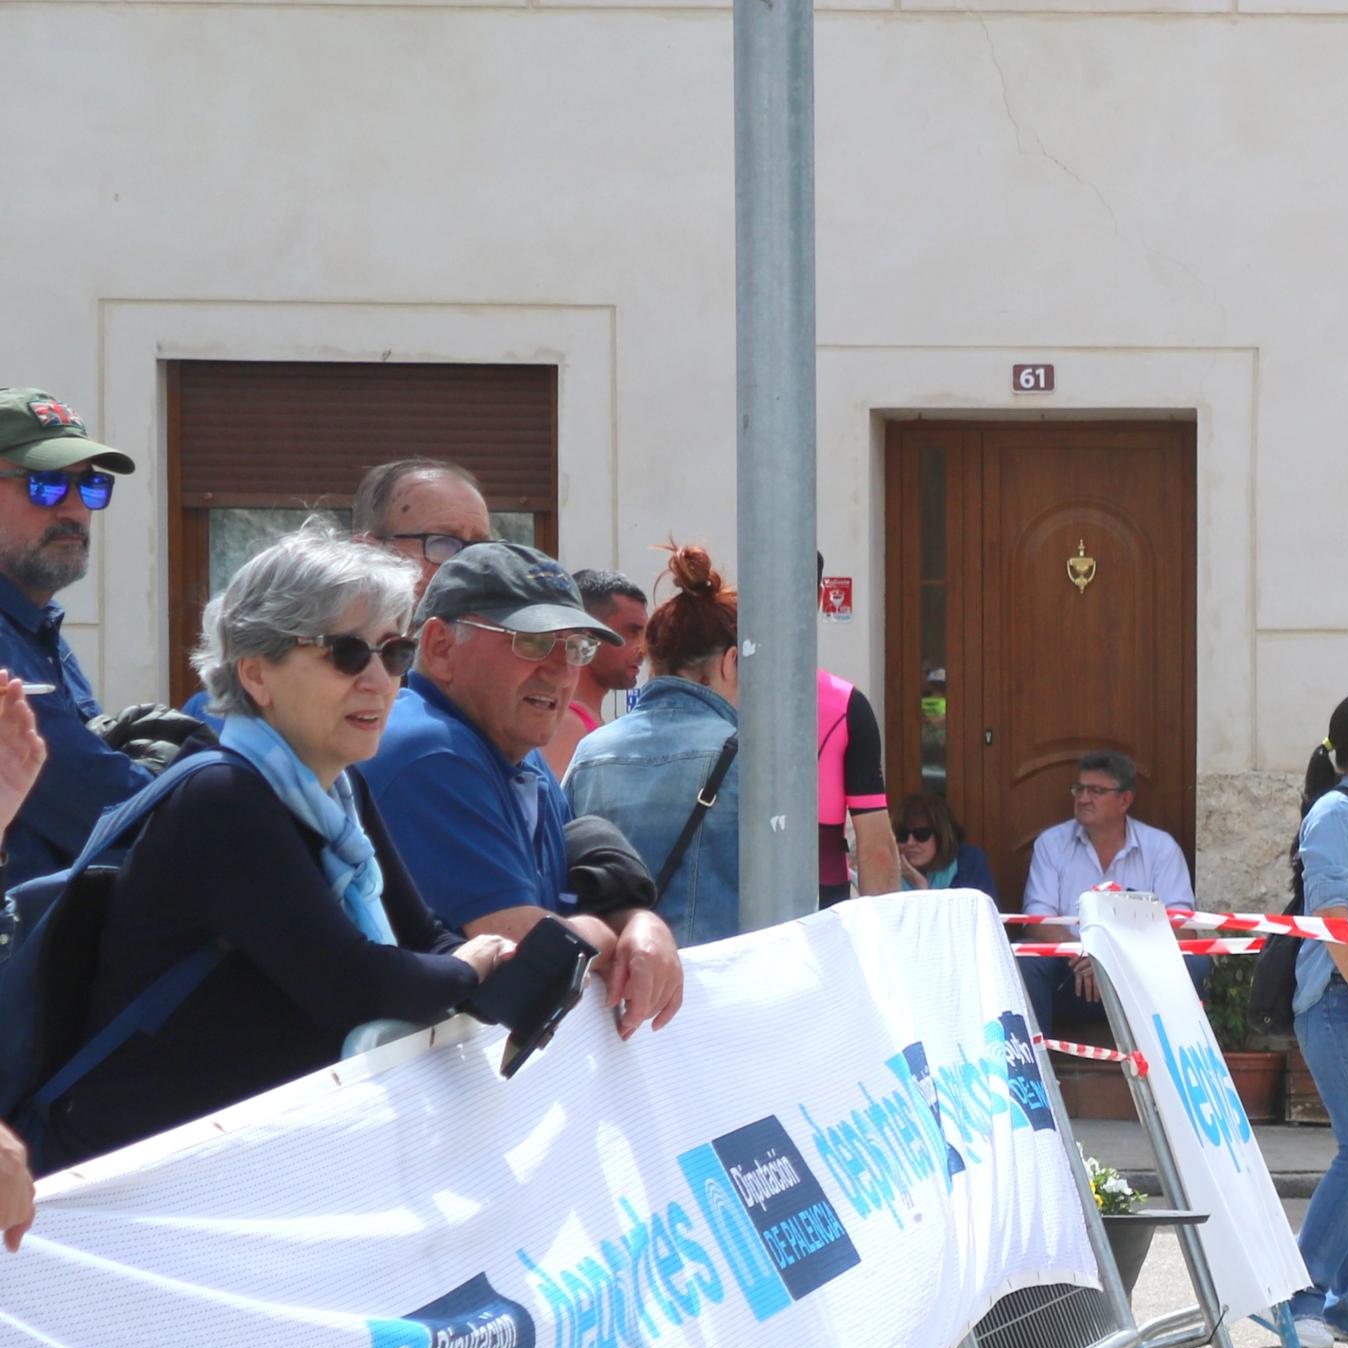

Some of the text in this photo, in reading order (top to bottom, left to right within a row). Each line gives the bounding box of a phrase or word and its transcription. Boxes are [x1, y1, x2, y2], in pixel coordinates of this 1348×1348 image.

[1020, 368, 1045, 389] 61
[730, 1149, 800, 1212] Diputación
[763, 1199, 846, 1271] DE PALENCIA
